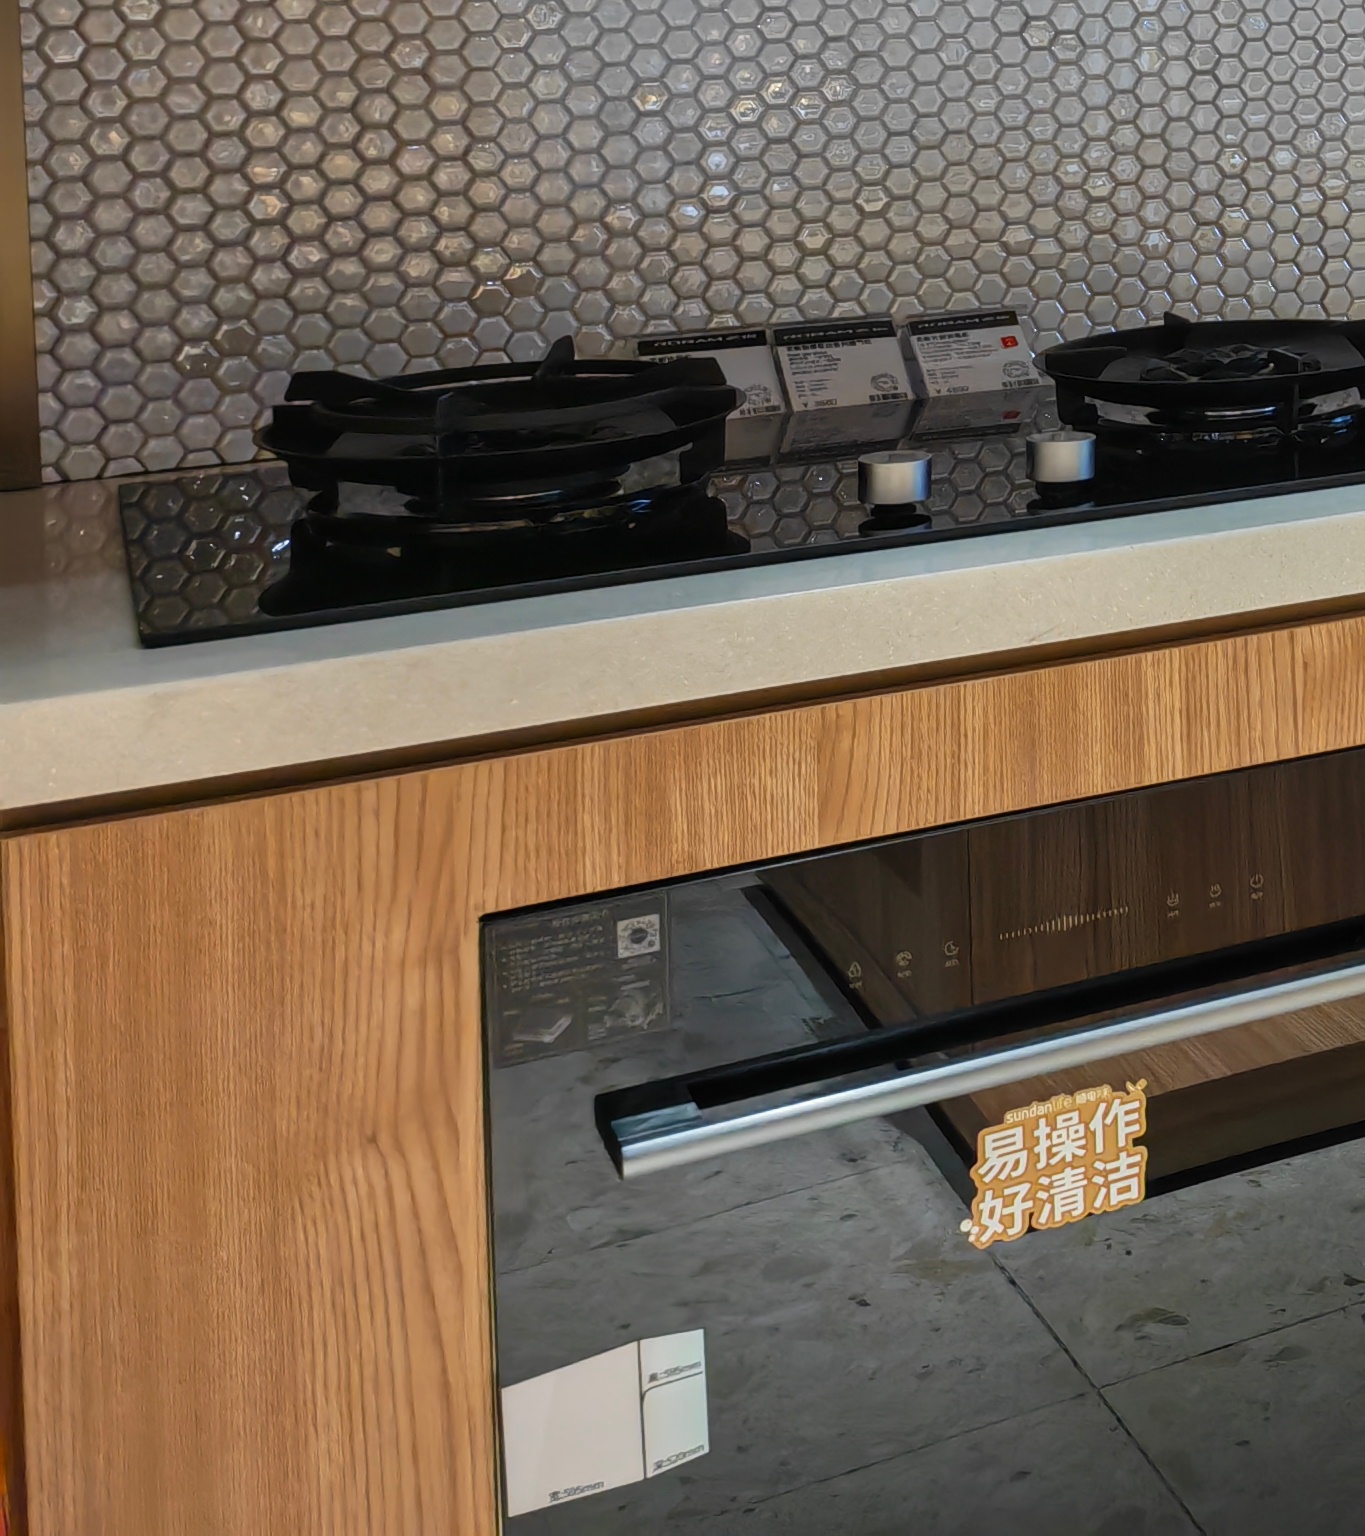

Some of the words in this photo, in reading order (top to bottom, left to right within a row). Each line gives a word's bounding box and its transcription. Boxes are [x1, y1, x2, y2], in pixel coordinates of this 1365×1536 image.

[977, 1097, 1142, 1184] 易操作
[978, 1150, 1142, 1244] 好清洁
